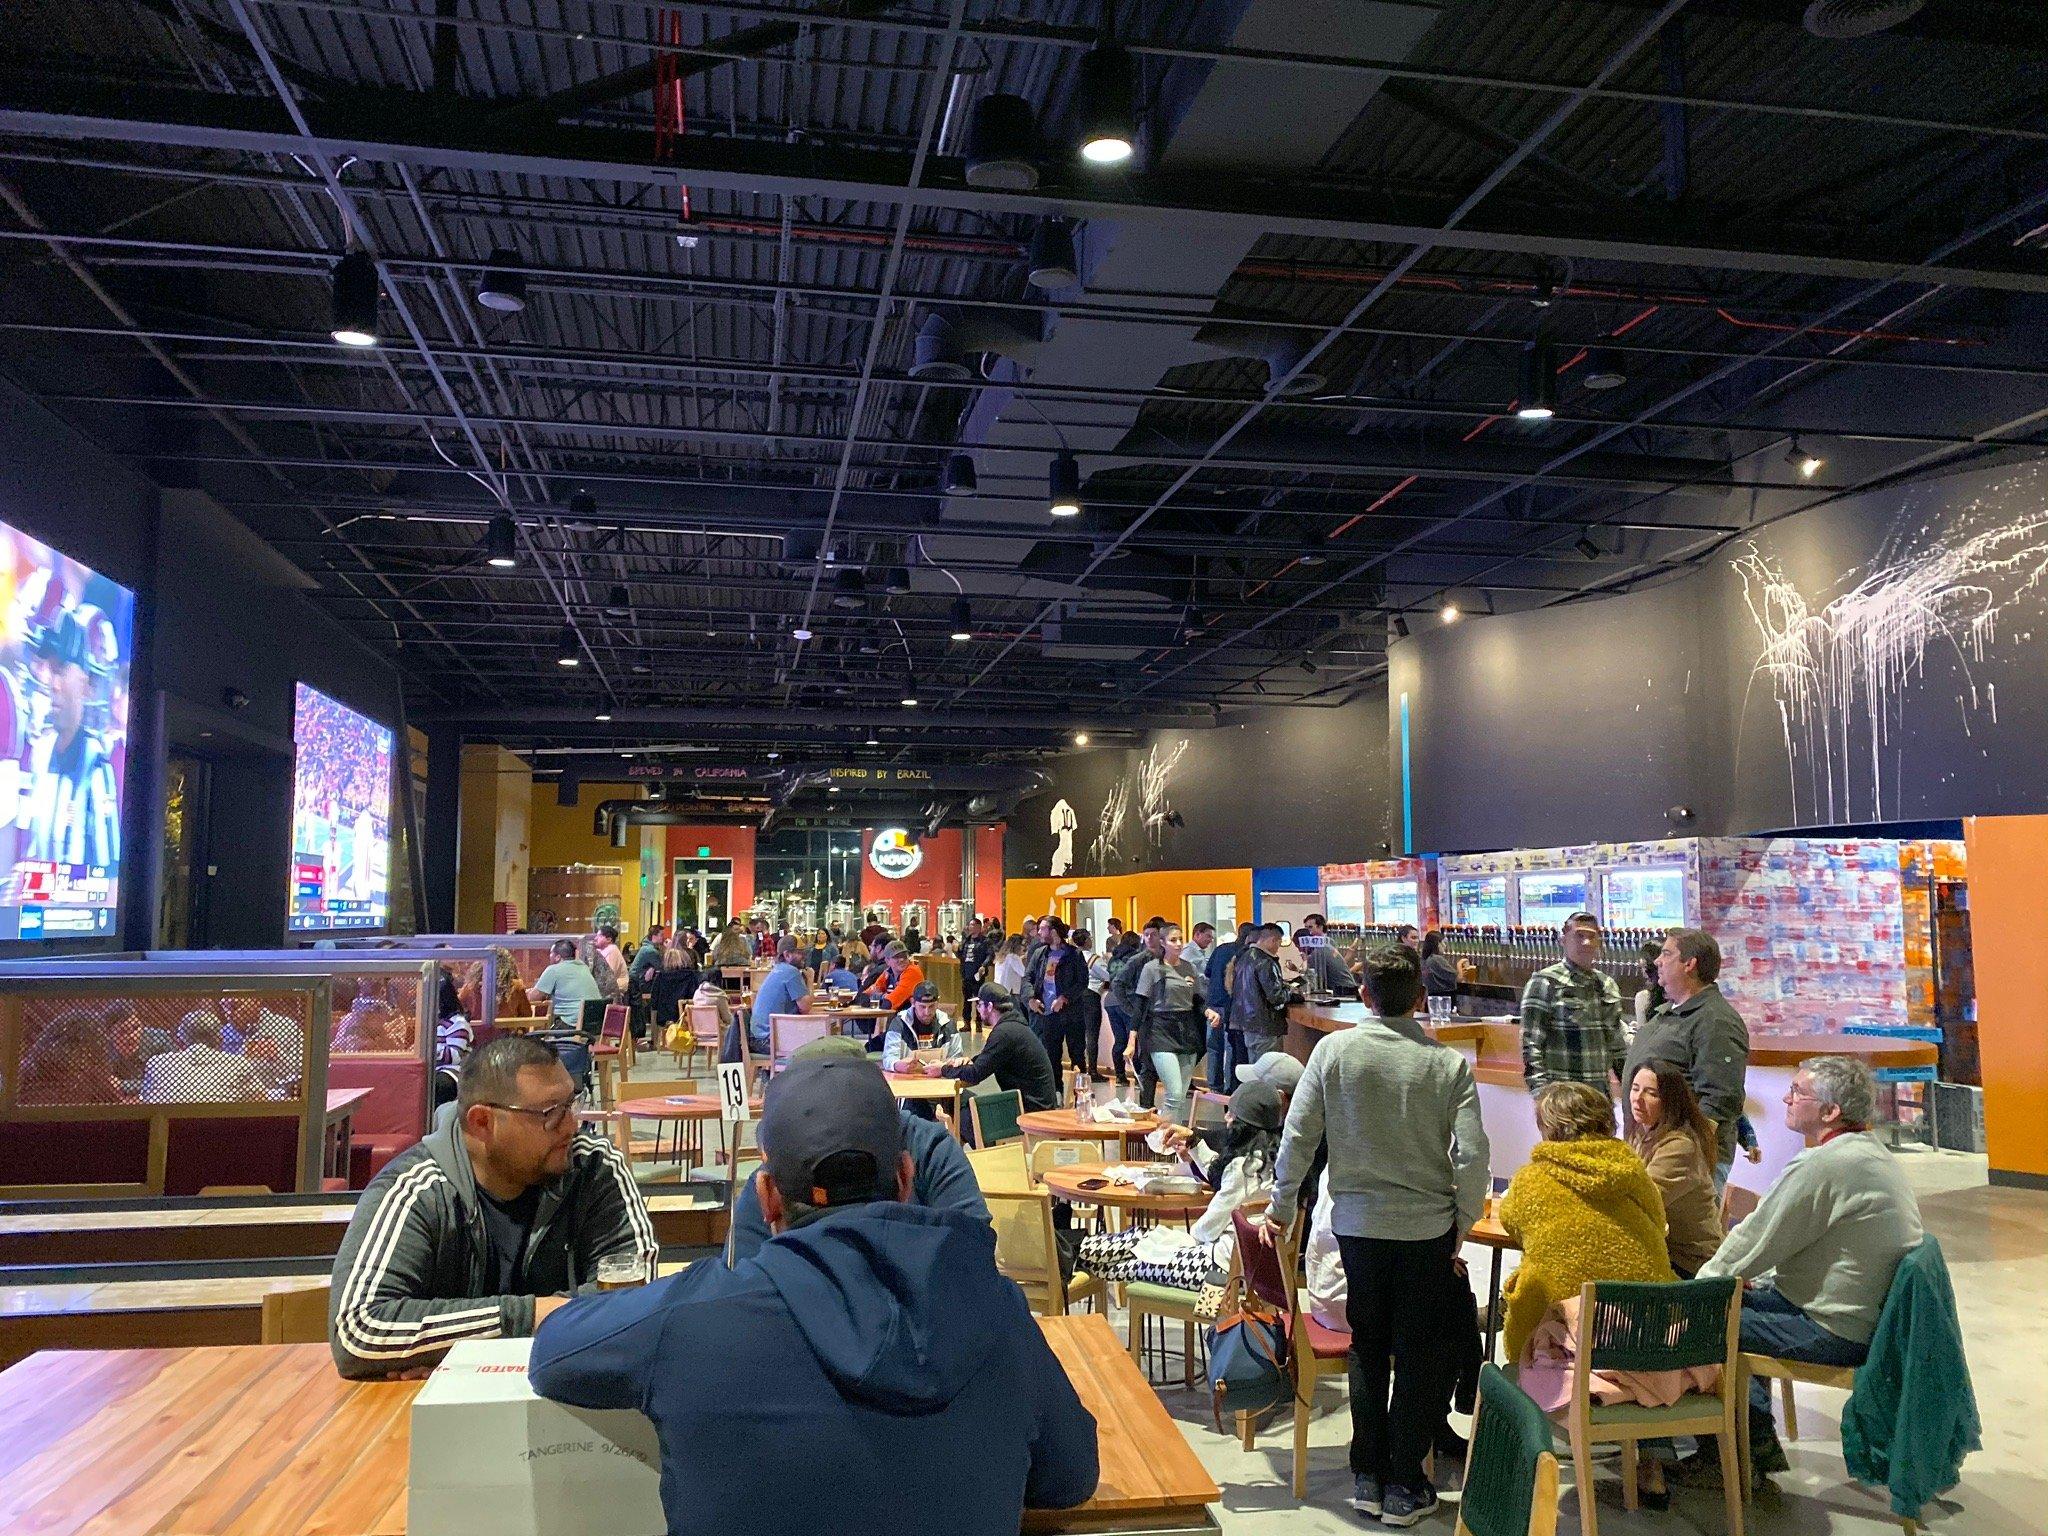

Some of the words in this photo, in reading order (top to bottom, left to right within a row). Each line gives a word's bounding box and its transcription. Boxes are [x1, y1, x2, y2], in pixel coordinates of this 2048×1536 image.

[695, 768, 747, 777] CALIFORNIA
[830, 768, 867, 778] INSPIRED
[876, 769, 887, 779] BY
[897, 769, 931, 779] BRAZIL
[879, 854, 912, 866] NOVO
[722, 1069, 743, 1106] 19
[518, 1441, 594, 1461] TANGERINE
